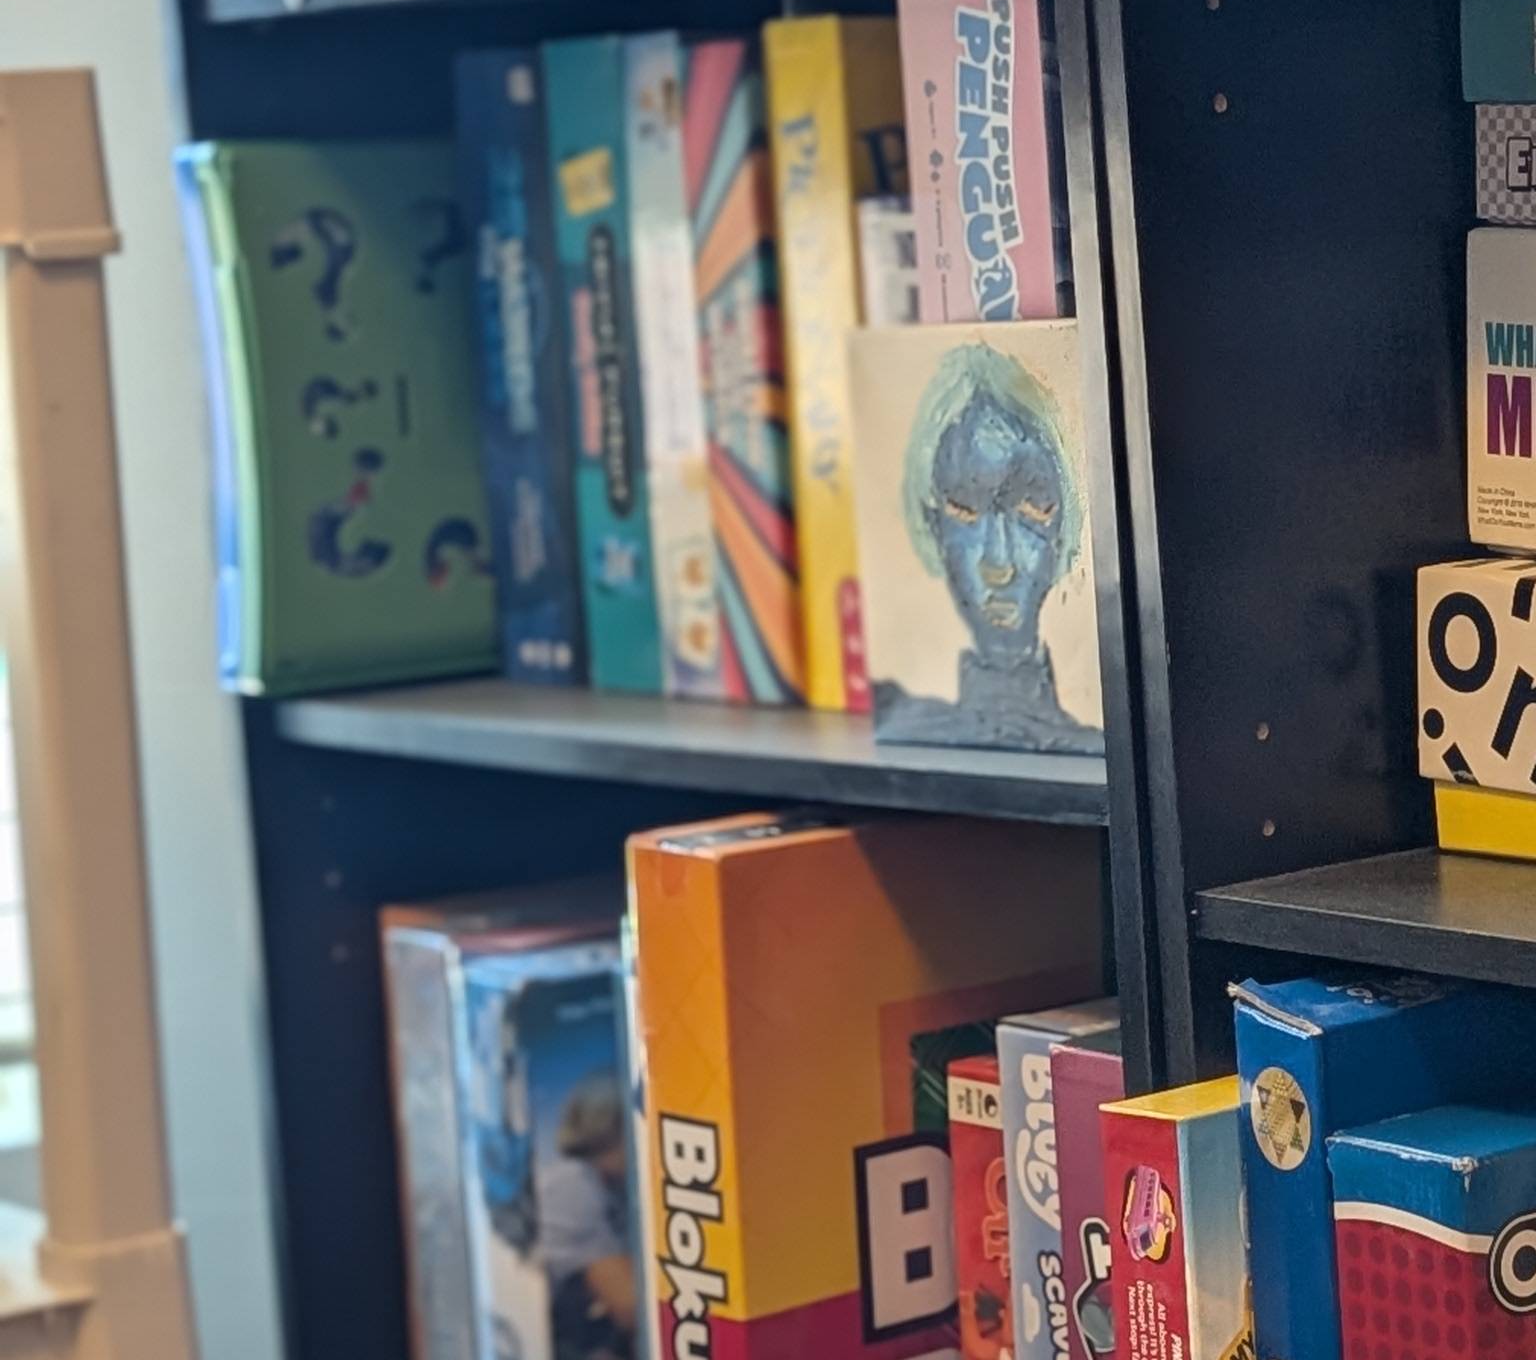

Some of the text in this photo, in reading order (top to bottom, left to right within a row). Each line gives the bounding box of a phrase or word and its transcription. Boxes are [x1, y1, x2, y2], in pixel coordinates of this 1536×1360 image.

[991, 124, 1020, 243] PUSH
[1127, 1285, 1138, 1316] Next
[1136, 1280, 1147, 1332] through
